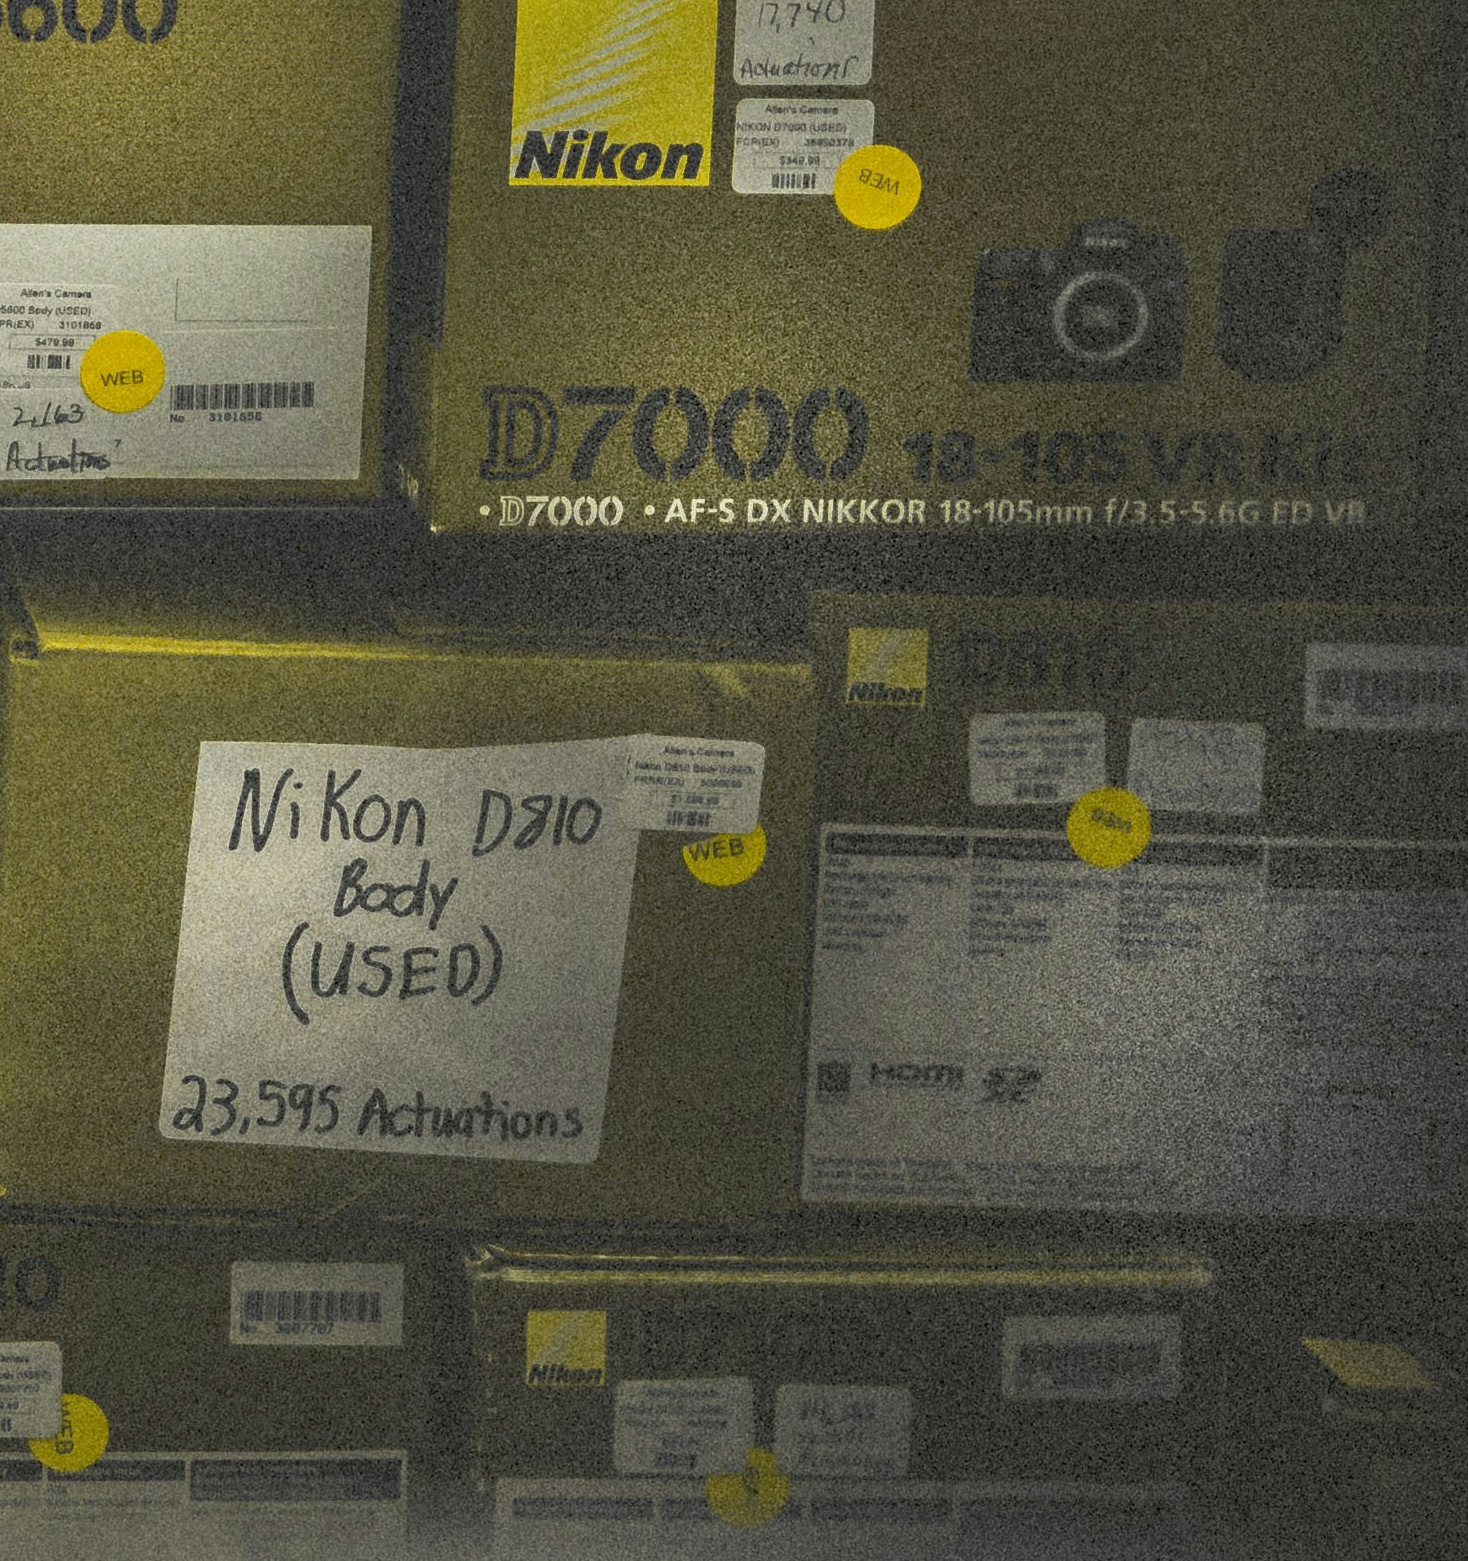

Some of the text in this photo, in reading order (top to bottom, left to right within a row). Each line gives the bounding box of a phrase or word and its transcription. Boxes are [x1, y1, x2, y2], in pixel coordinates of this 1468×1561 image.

[514, 130, 703, 181] Nikon
[99, 370, 145, 388] WEB
[478, 387, 1366, 484] D7000 18-105 VR Kit
[497, 494, 1366, 529] D7000 AF-S DX NIKKOR 18-105mm f/3.5-5.6G ED VR
[229, 768, 602, 857] Nikon D810
[335, 858, 458, 930] Body
[283, 922, 504, 1025] (USED)
[173, 1076, 583, 1140] 23,595 Actuations
